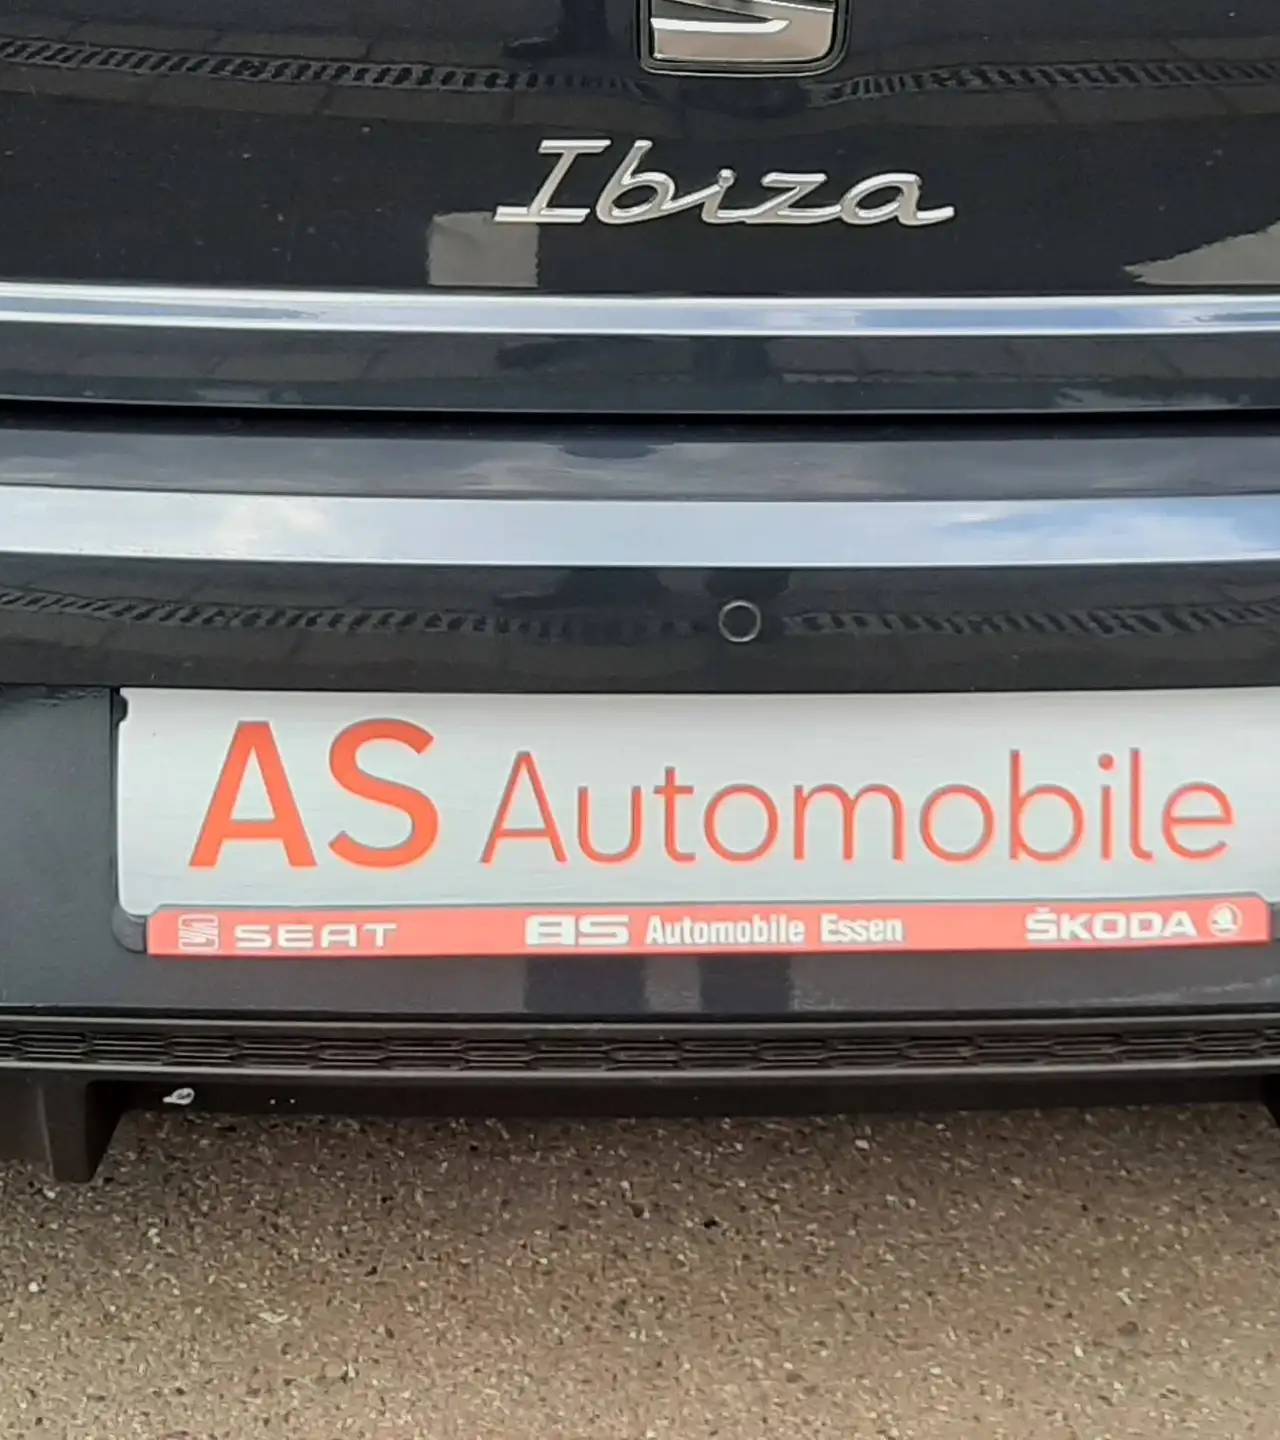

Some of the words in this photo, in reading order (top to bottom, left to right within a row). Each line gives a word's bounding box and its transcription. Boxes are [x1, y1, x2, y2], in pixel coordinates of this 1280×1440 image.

[492, 138, 956, 227] Ibiza
[188, 718, 441, 870] AS
[479, 749, 1234, 867] Automobile
[234, 923, 397, 948] SEAT
[645, 913, 806, 946] Automobile
[820, 912, 904, 944] Essen
[1025, 906, 1198, 941] ŠKODA
